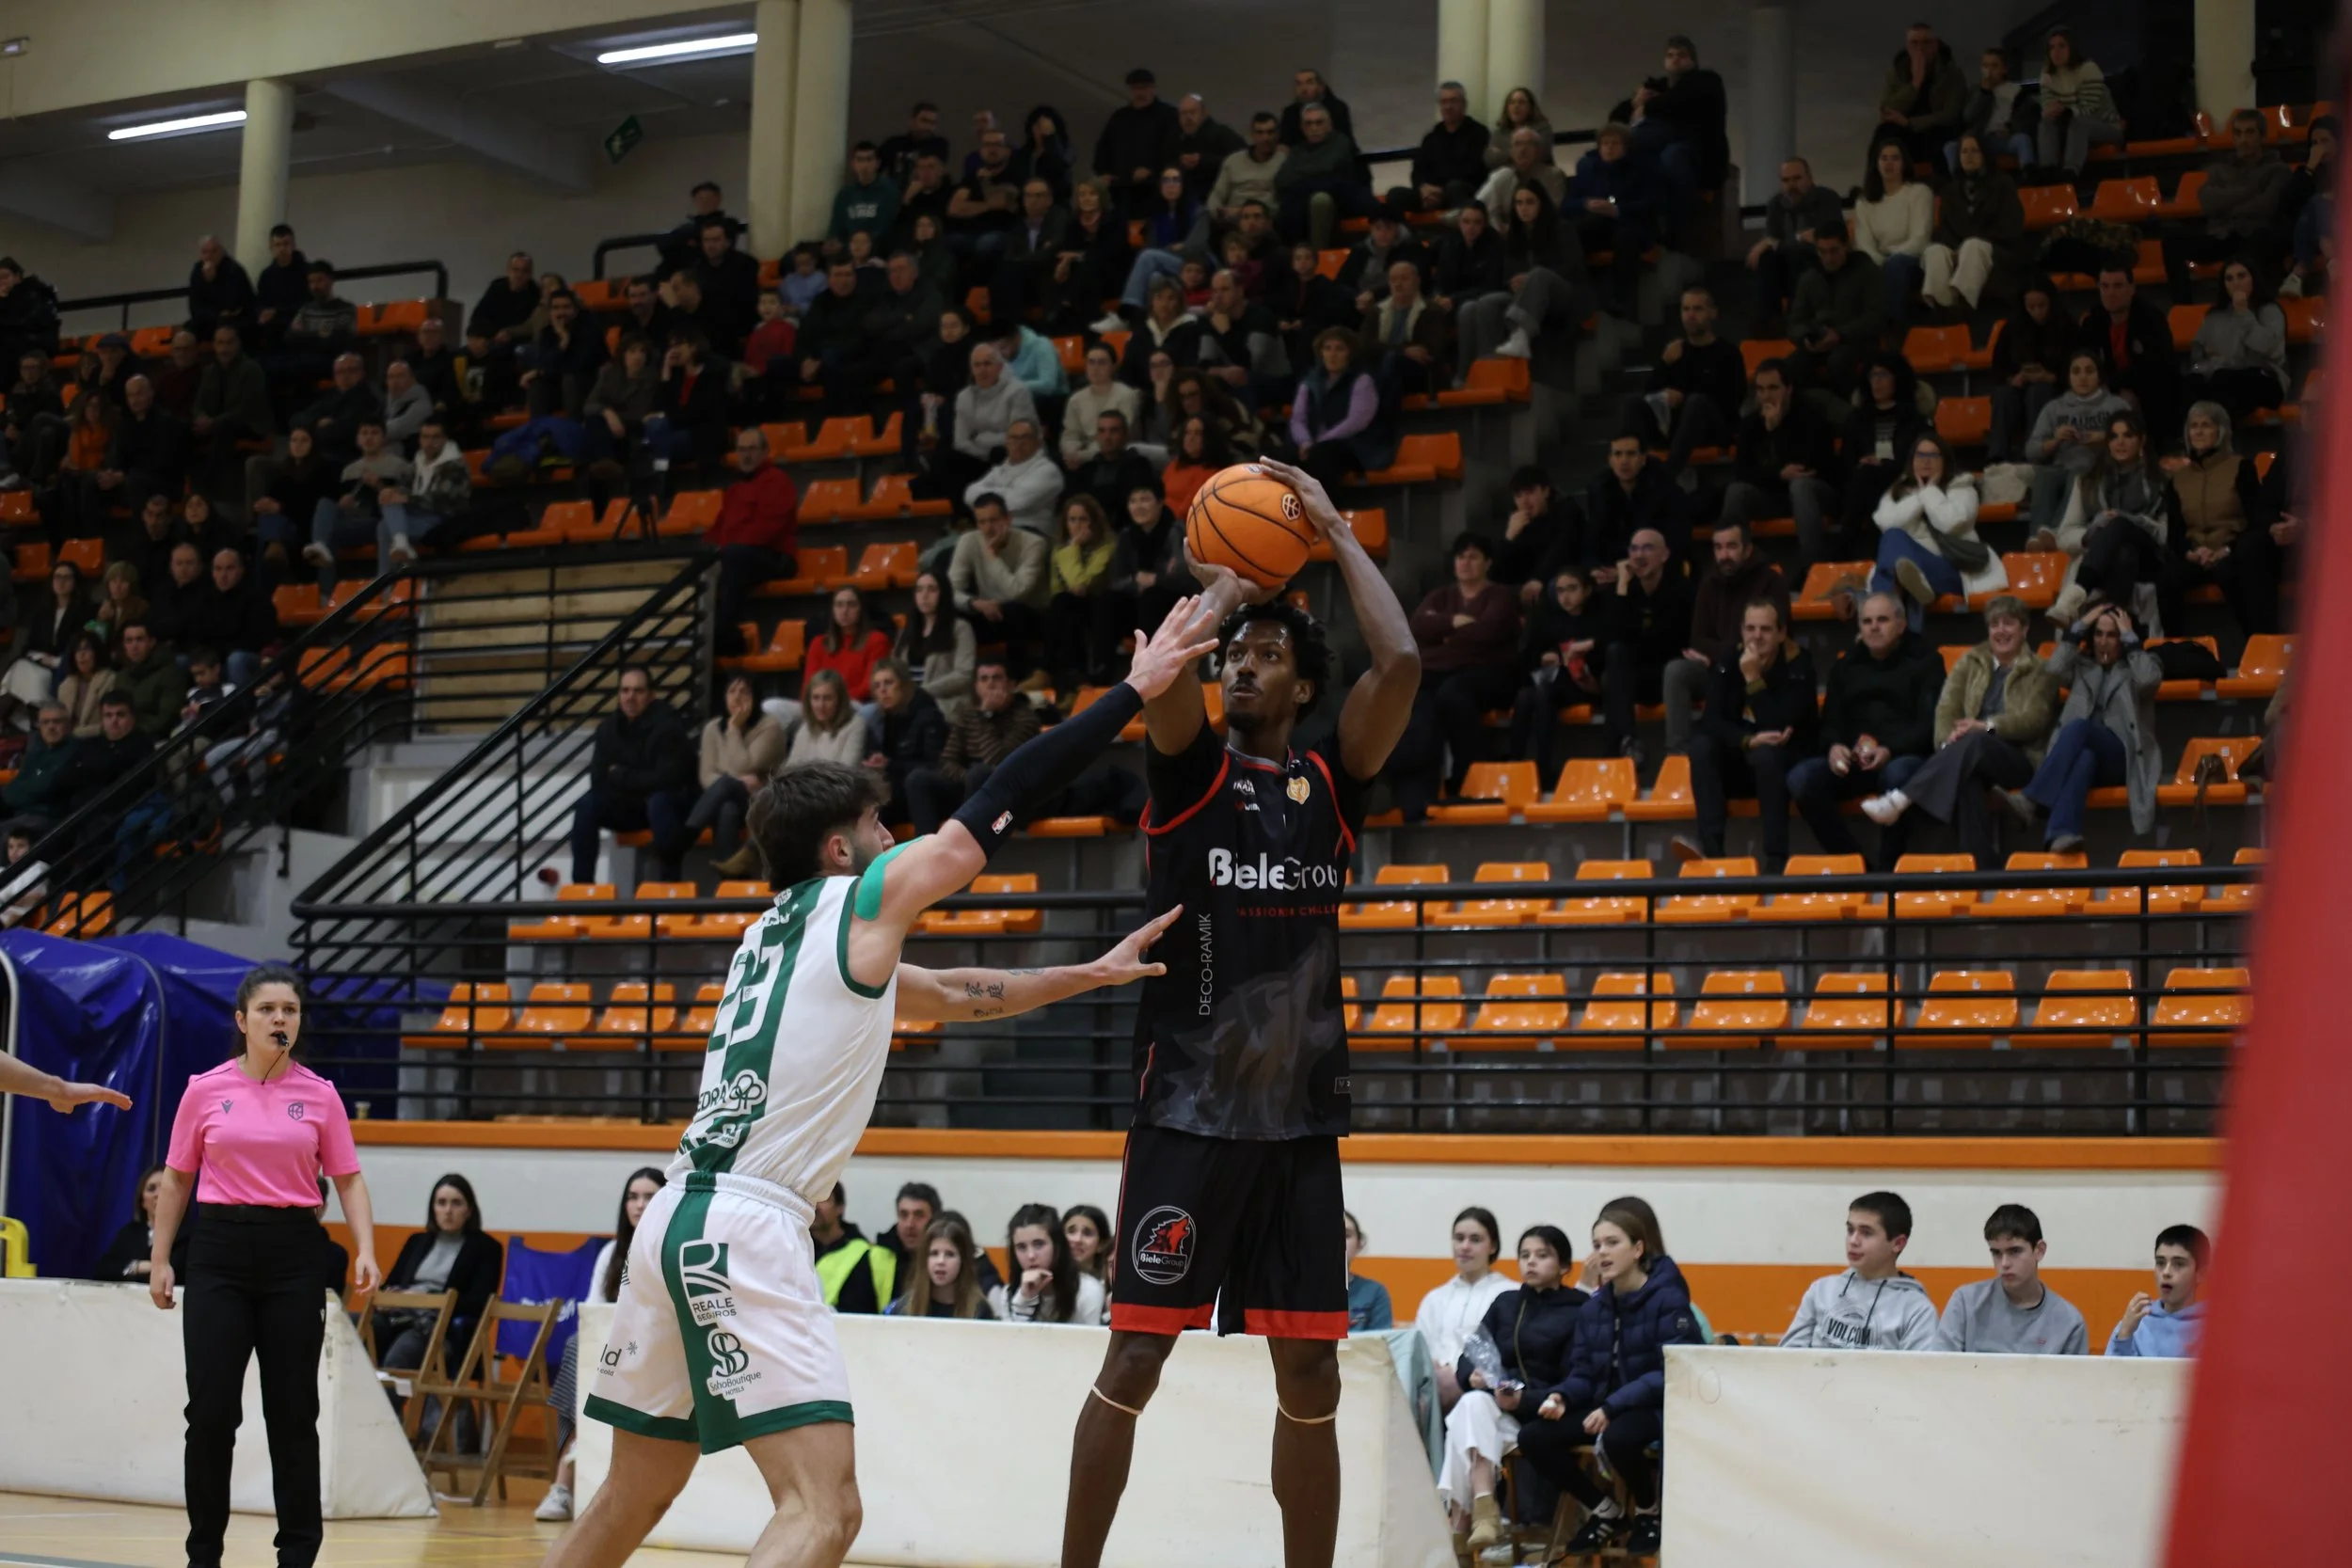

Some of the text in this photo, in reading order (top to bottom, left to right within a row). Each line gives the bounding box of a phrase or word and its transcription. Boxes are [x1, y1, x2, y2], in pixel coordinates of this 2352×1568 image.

[1199, 912, 1212, 1016] DECO-RAMIK
[1139, 1252, 1184, 1267] BieleGroup
[691, 1296, 735, 1313] REALE
[709, 1371, 762, 1393] SohoBoutique
[725, 1386, 745, 1397] HOTELS
